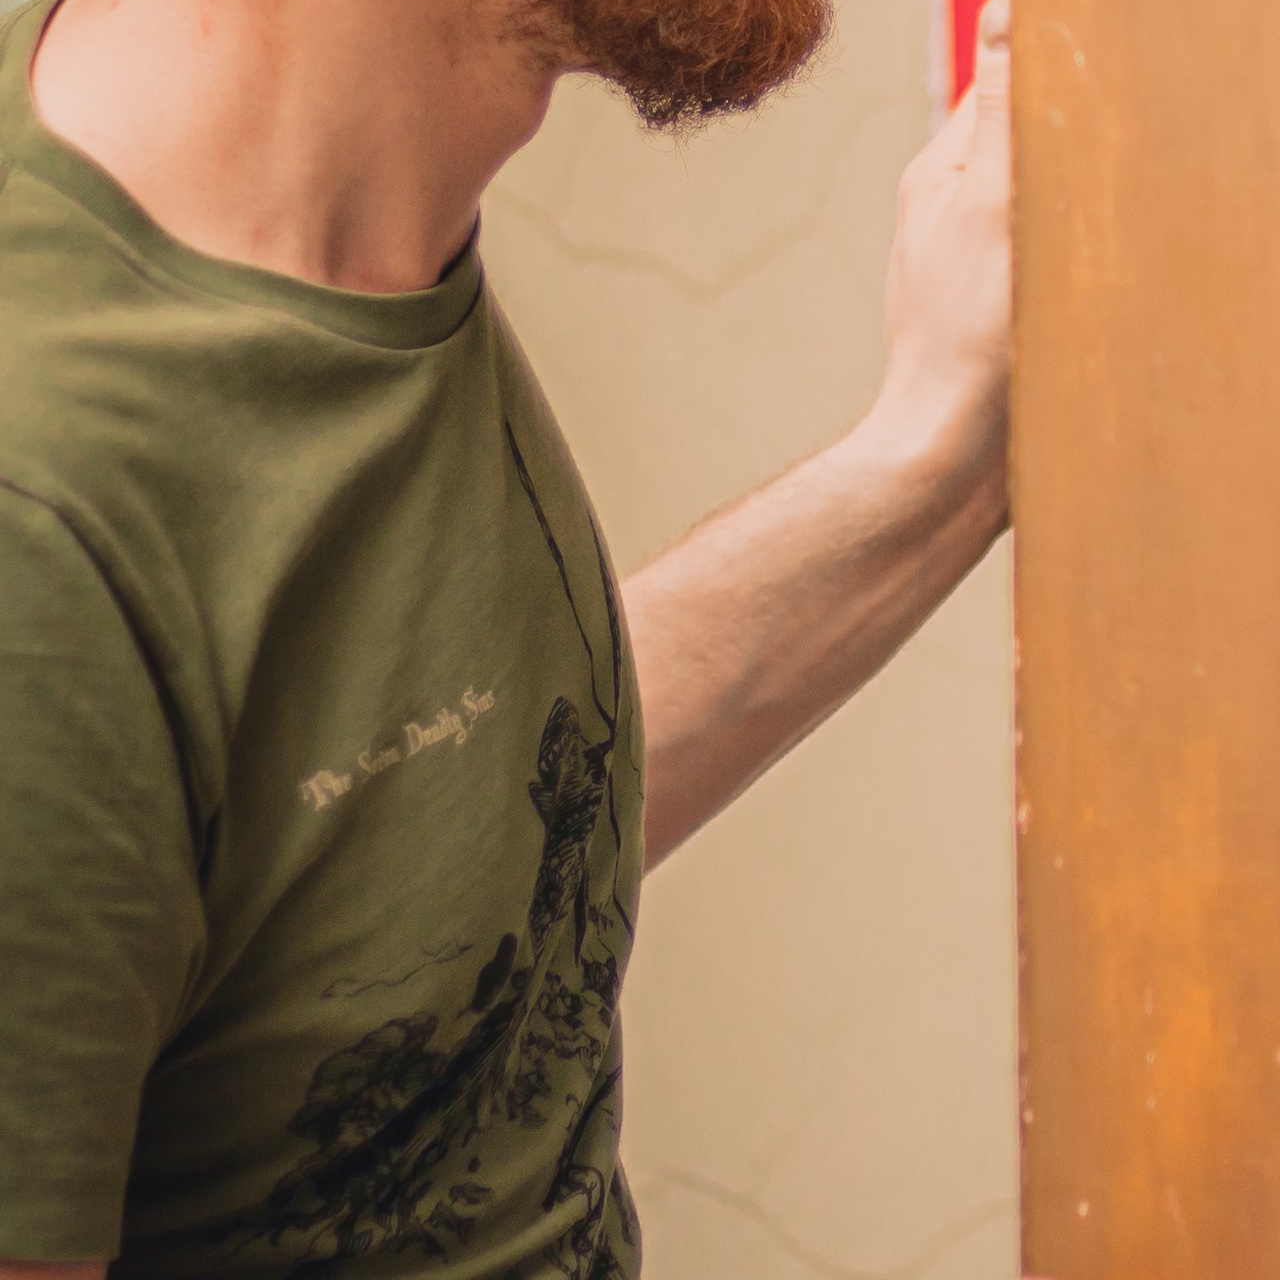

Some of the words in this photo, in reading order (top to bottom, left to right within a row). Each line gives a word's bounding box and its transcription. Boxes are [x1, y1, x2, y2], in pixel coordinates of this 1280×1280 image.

[299, 768, 353, 811] The
[403, 706, 467, 758] Deadly
[461, 684, 495, 731] Sins
